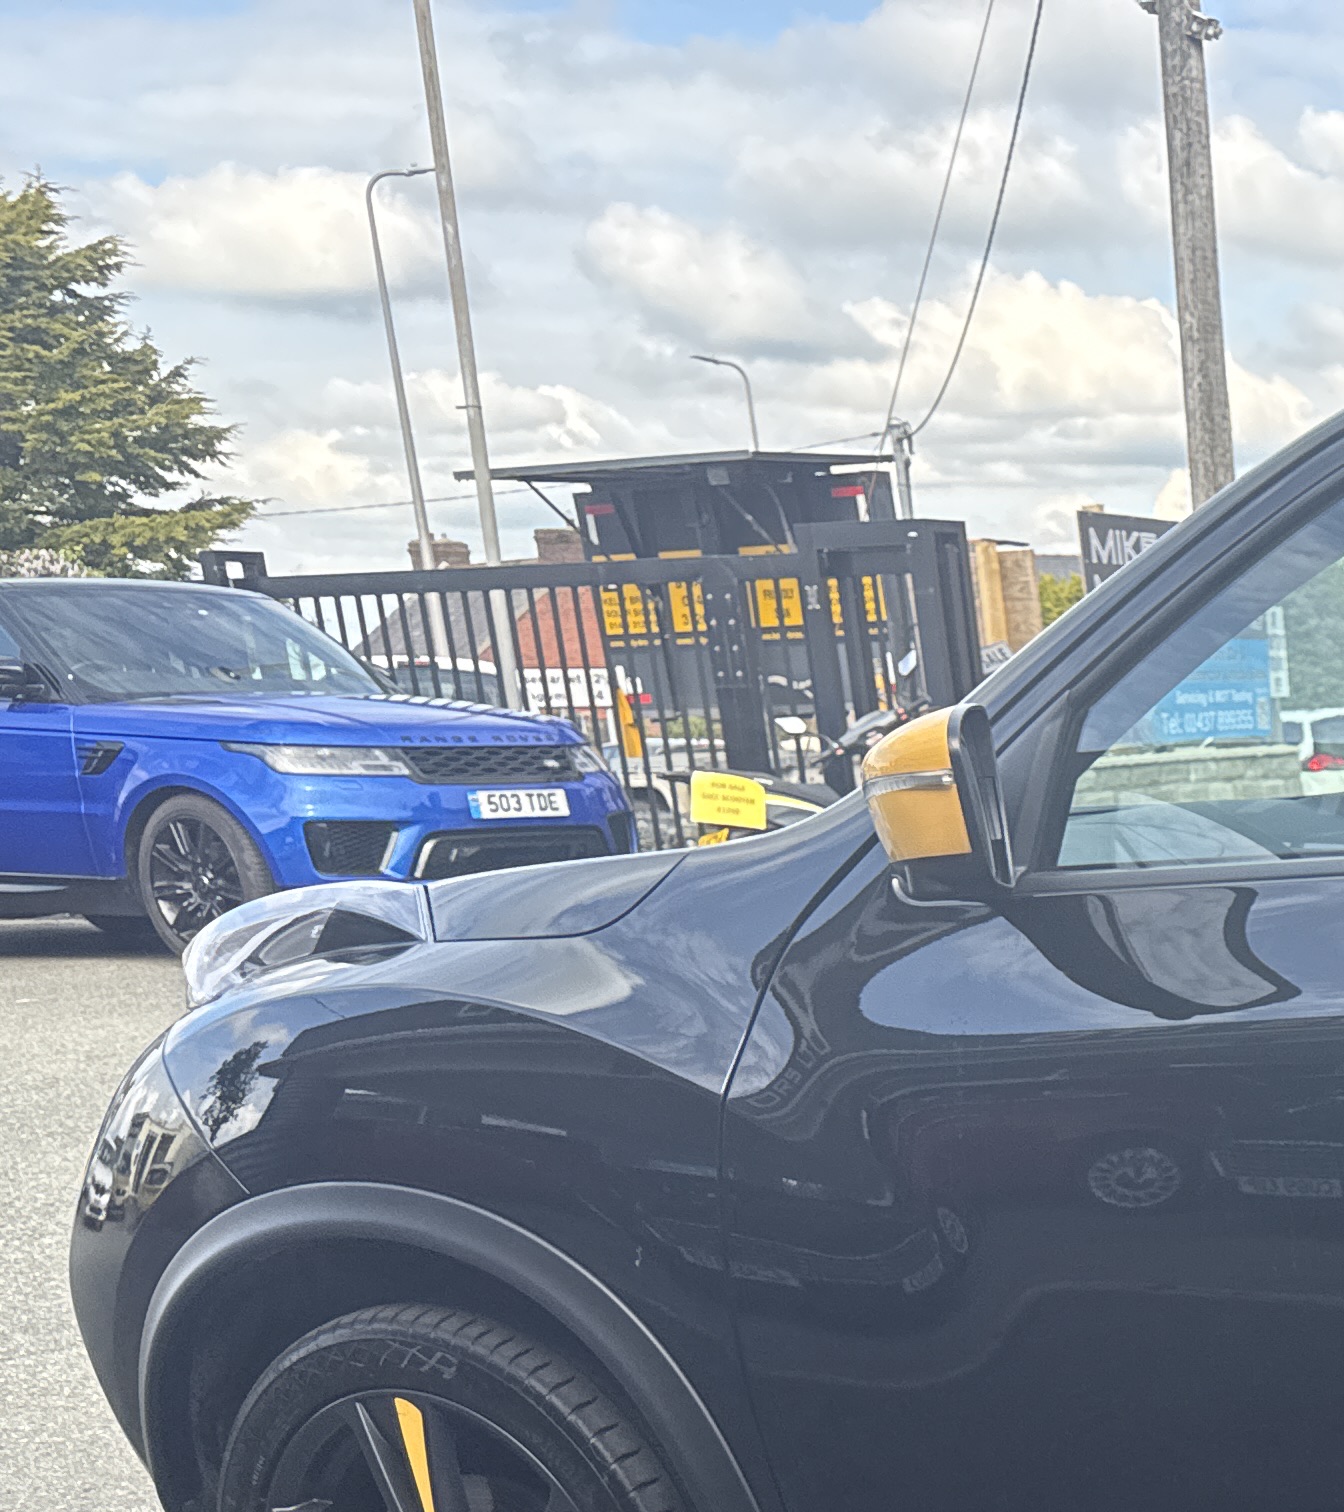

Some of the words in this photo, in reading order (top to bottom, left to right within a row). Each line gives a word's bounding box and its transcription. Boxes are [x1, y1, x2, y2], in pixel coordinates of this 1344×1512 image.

[401, 735, 478, 743] RANGE
[491, 735, 555, 743] ROVER
[487, 792, 522, 813] 503
[525, 792, 560, 812] TDE
